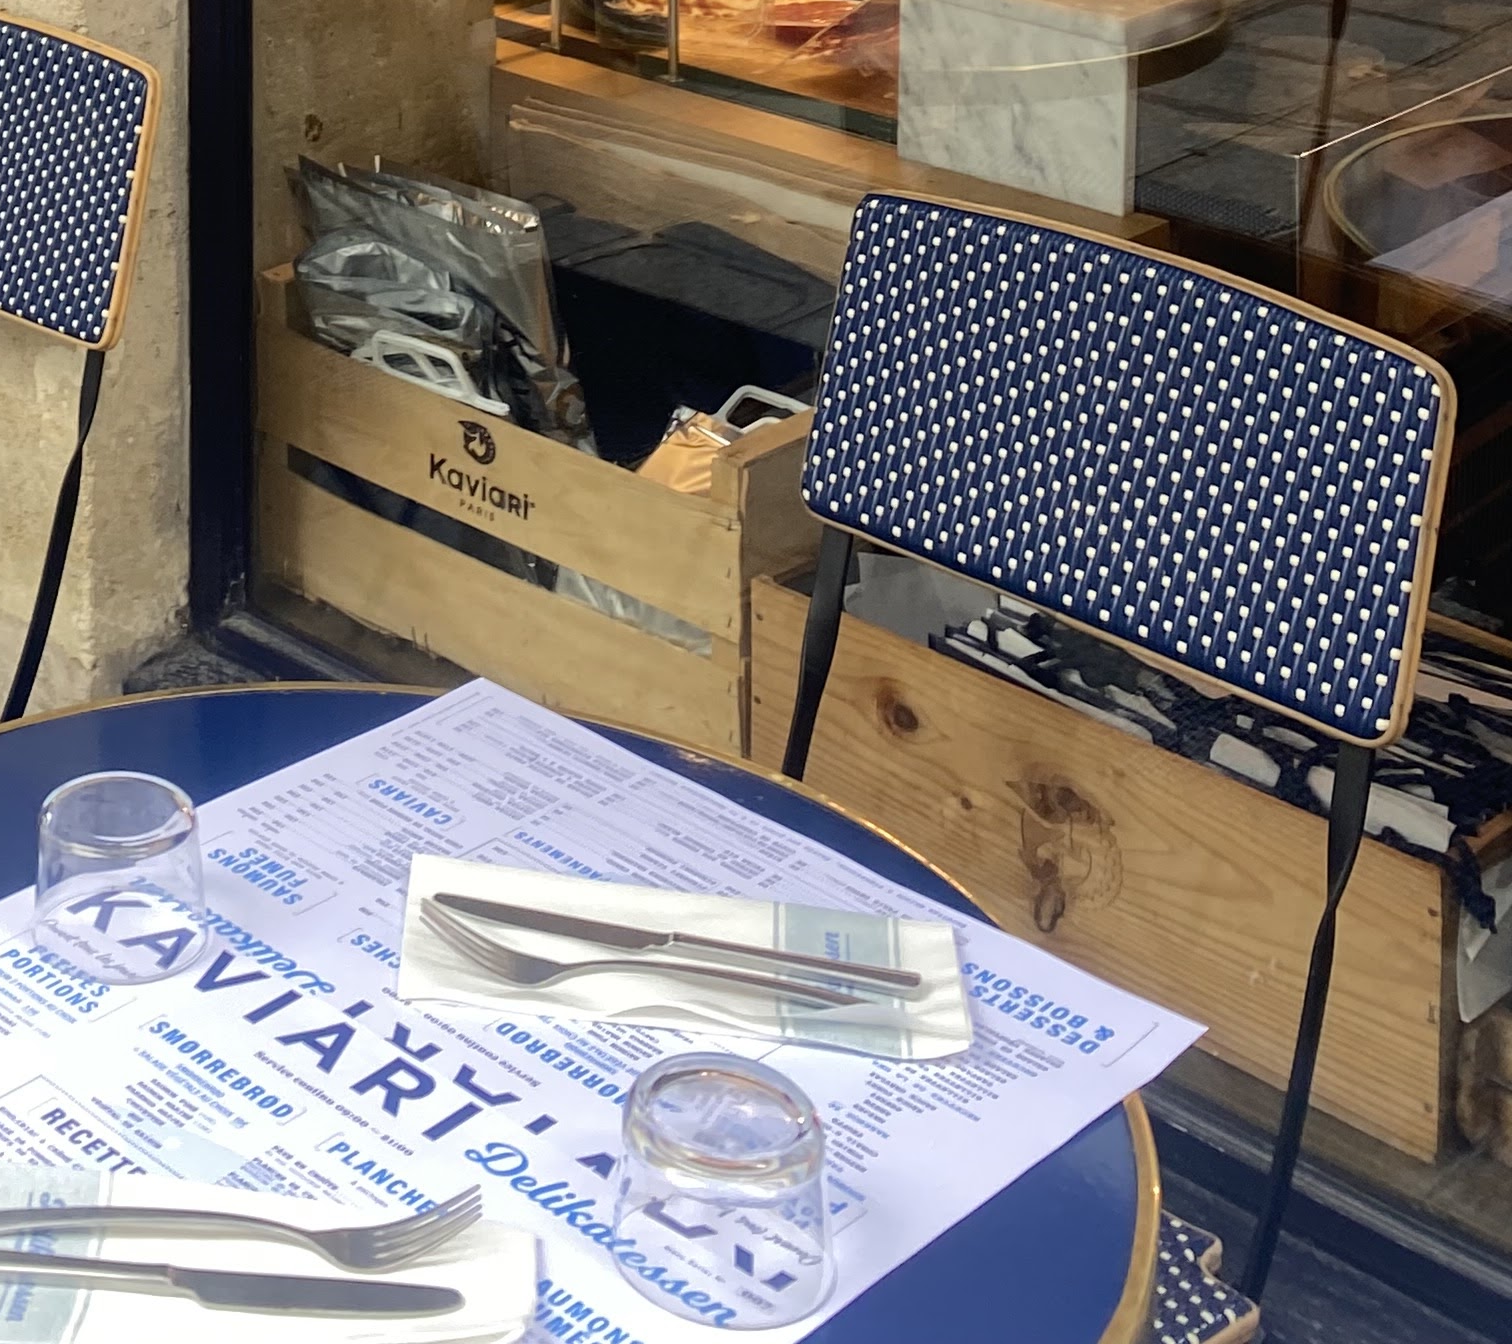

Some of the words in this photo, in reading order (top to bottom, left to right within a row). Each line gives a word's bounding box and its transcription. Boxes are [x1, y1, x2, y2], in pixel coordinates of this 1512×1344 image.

[459, 499, 495, 521] PARIS
[368, 780, 452, 824] CAVIARS
[207, 847, 303, 906] SAUMONS
[239, 847, 309, 891] FUMÉS
[0, 949, 98, 1013] PORTIONS
[351, 934, 400, 969] CHES
[960, 962, 1088, 1033] BOISSONS
[966, 983, 1100, 1054] DESSERTS
[1095, 1026, 1114, 1041] &
[150, 1022, 293, 1117] SMØRREBRØD
[254, 1051, 294, 1078] Service
[293, 1078, 334, 1105] continu
[498, 1060, 541, 1087] Service
[64, 890, 486, 1144] KAVIARI
[465, 1141, 738, 1328] Delikatessen
[41, 1108, 146, 1175] RECETT
[327, 1142, 441, 1215] PLANCHE
